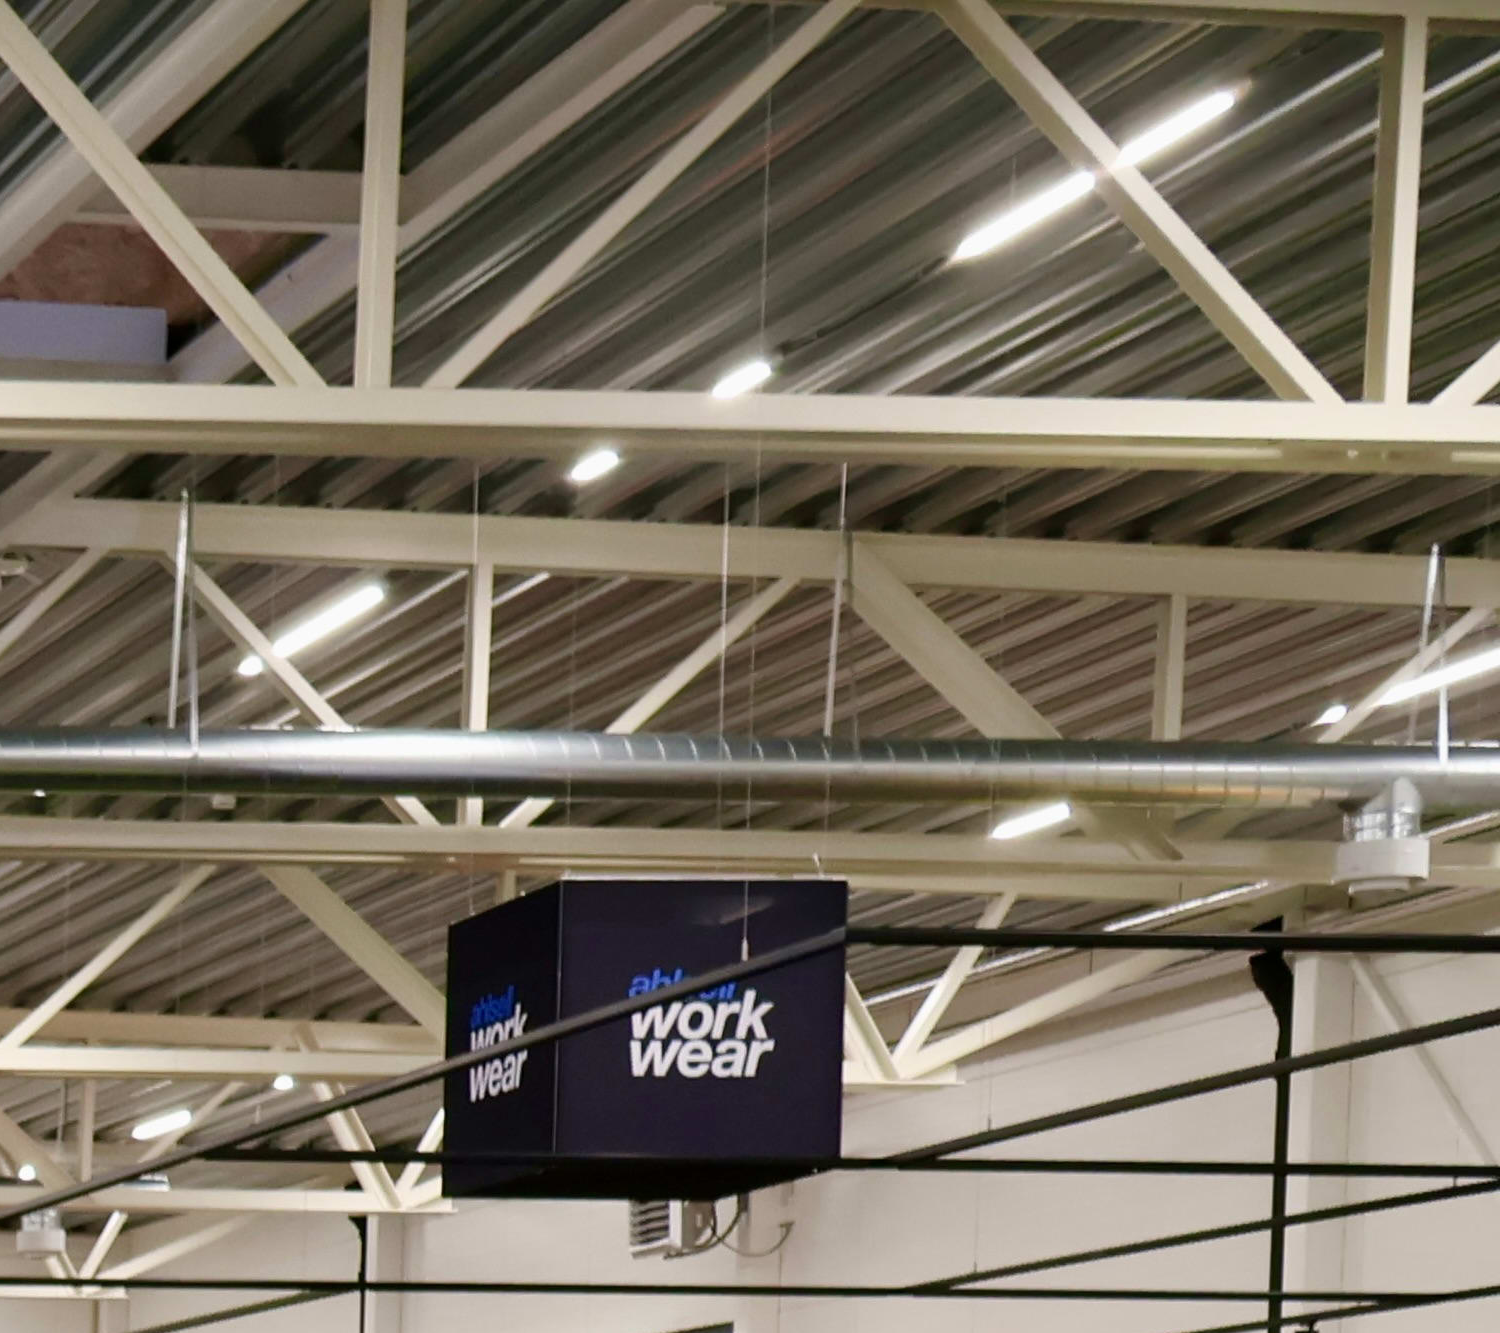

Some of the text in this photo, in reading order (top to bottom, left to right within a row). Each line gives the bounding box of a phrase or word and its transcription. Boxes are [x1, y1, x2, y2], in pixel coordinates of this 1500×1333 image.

[631, 989, 774, 1040] work
[469, 1048, 528, 1103] wear
[630, 1039, 775, 1079] wear
